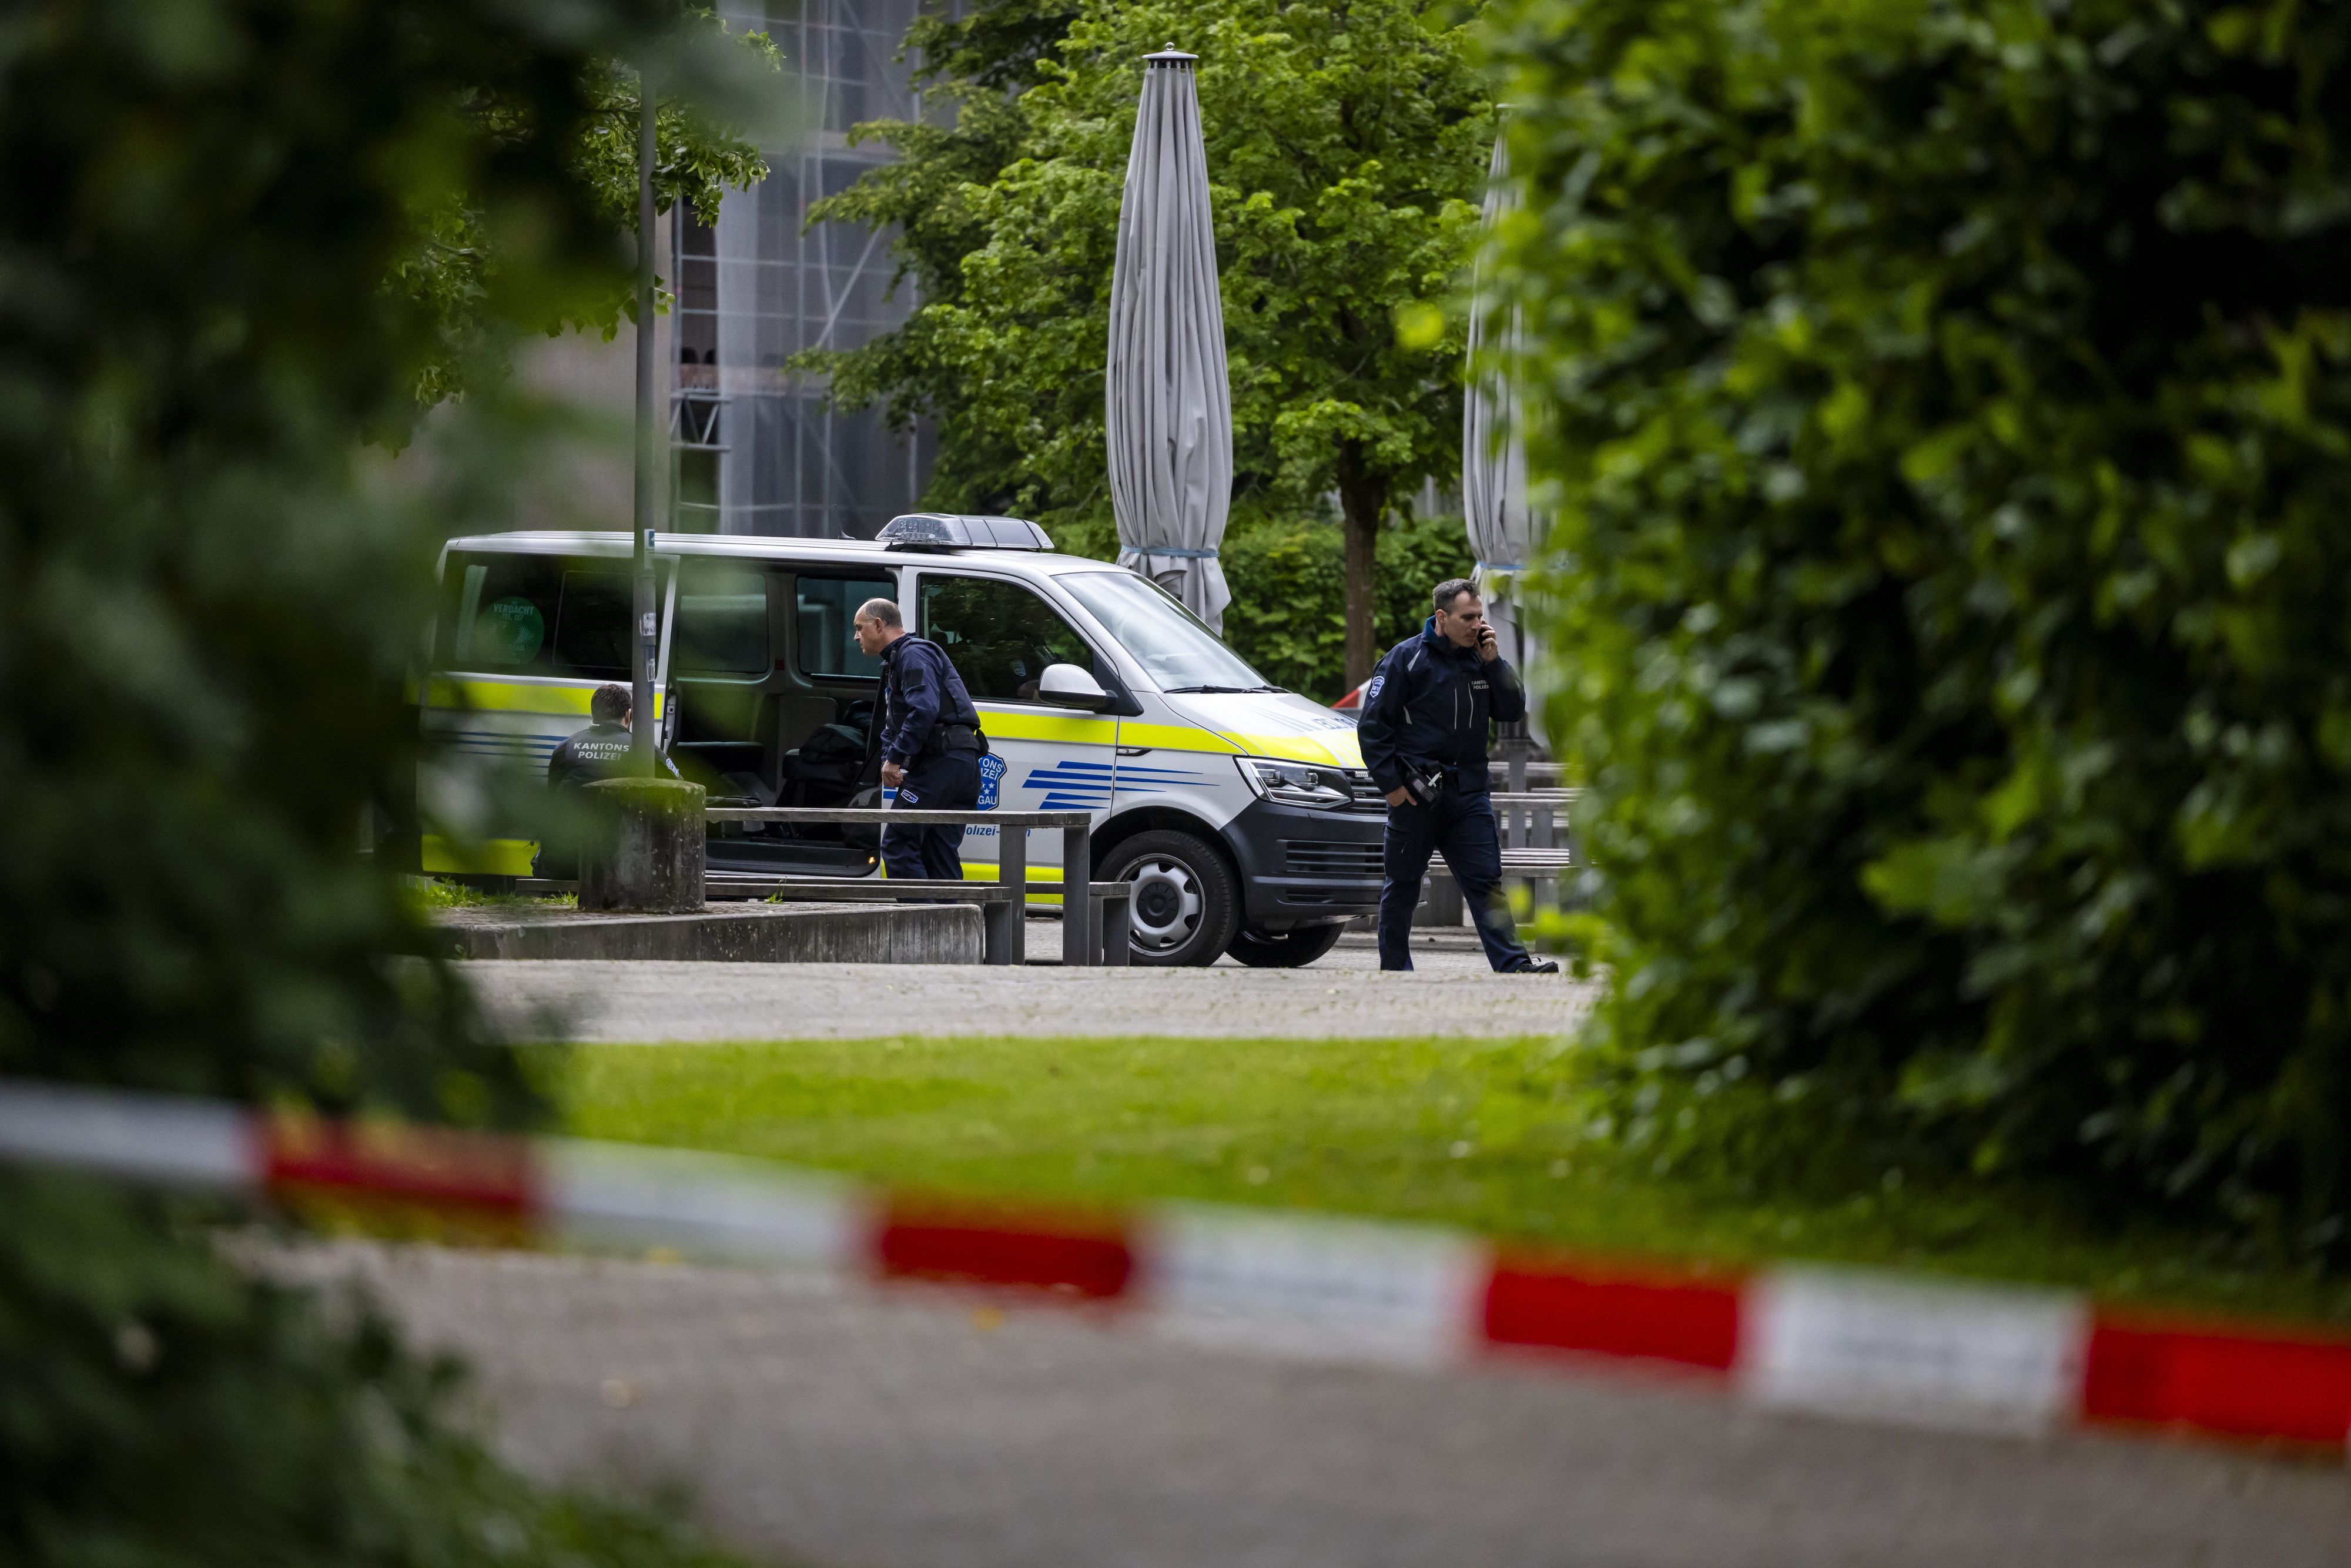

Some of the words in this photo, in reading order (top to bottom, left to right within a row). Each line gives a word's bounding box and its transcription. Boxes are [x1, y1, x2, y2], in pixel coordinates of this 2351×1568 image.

[494, 604, 535, 615] VERDACHT
[573, 742, 630, 752] KANTONS
[578, 751, 621, 760] POLIZEI
